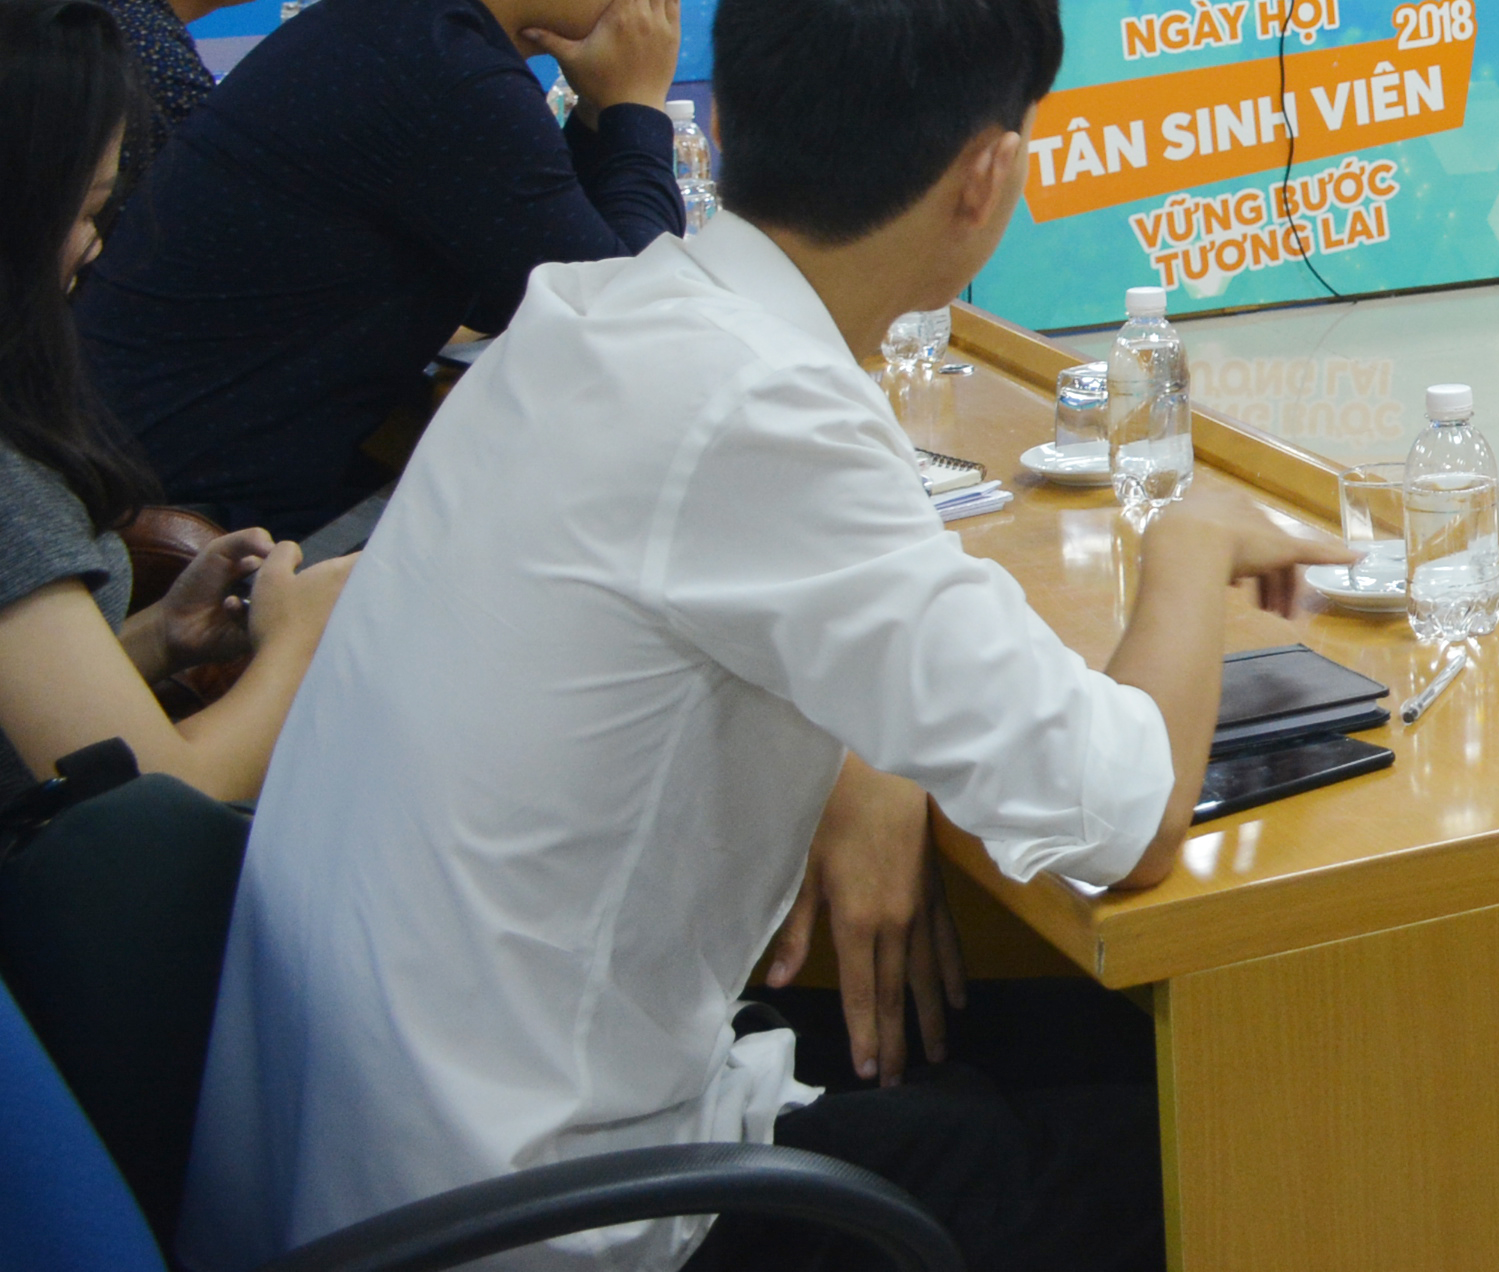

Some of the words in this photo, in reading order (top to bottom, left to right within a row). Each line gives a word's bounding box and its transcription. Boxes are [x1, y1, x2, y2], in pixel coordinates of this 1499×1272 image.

[1123, 0, 1250, 59] NGÀY
[1396, 0, 1474, 48] 2018
[1029, 118, 1147, 187] TÂN
[1162, 94, 1298, 160] SINH
[1311, 62, 1445, 130] VIÊN
[1130, 190, 1264, 250] VỮNG
[1277, 158, 1398, 219] BƯỚC
[1155, 223, 1311, 290] TƯƠNG
[1323, 204, 1390, 249] LAI
